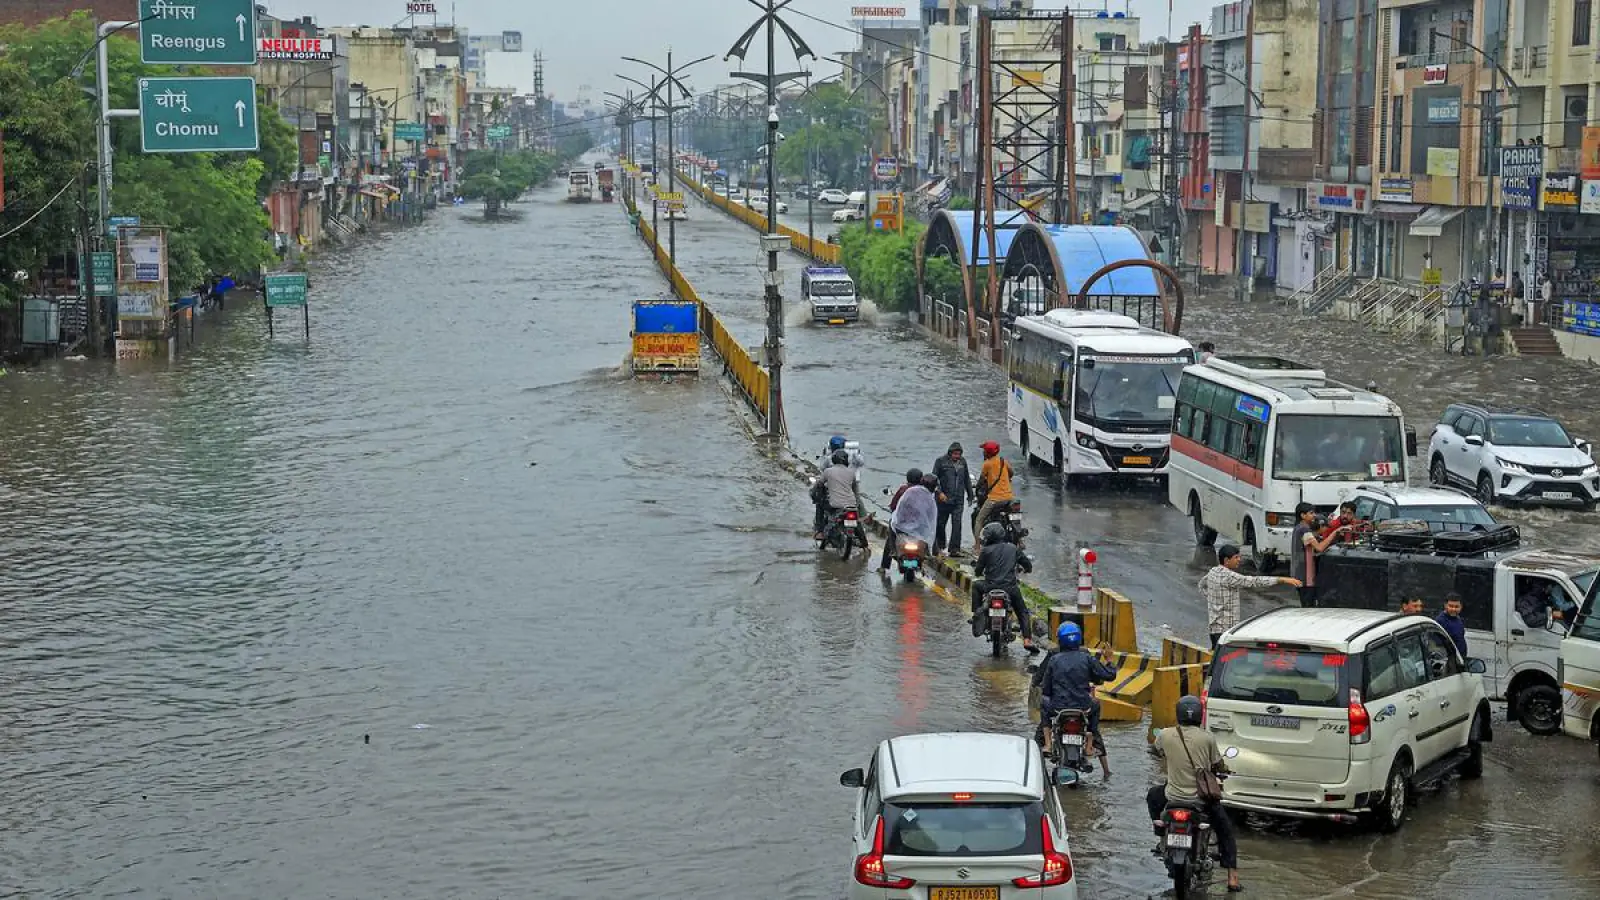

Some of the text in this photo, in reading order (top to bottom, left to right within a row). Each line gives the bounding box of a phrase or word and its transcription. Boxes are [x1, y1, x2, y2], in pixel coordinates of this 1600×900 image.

[150, 0, 196, 20] रींगस
[407, 3, 437, 13] HOTEL
[151, 34, 226, 52] Reengus
[262, 38, 321, 52] NEULIFE
[293, 52, 330, 60] HOSPITAL
[155, 122, 219, 136] Chomu
[1503, 148, 1541, 165] PAHAL
[1503, 163, 1542, 178] NUTRITION
[1376, 462, 1391, 476] 31
[938, 888, 997, 900] RJ52TA0503
